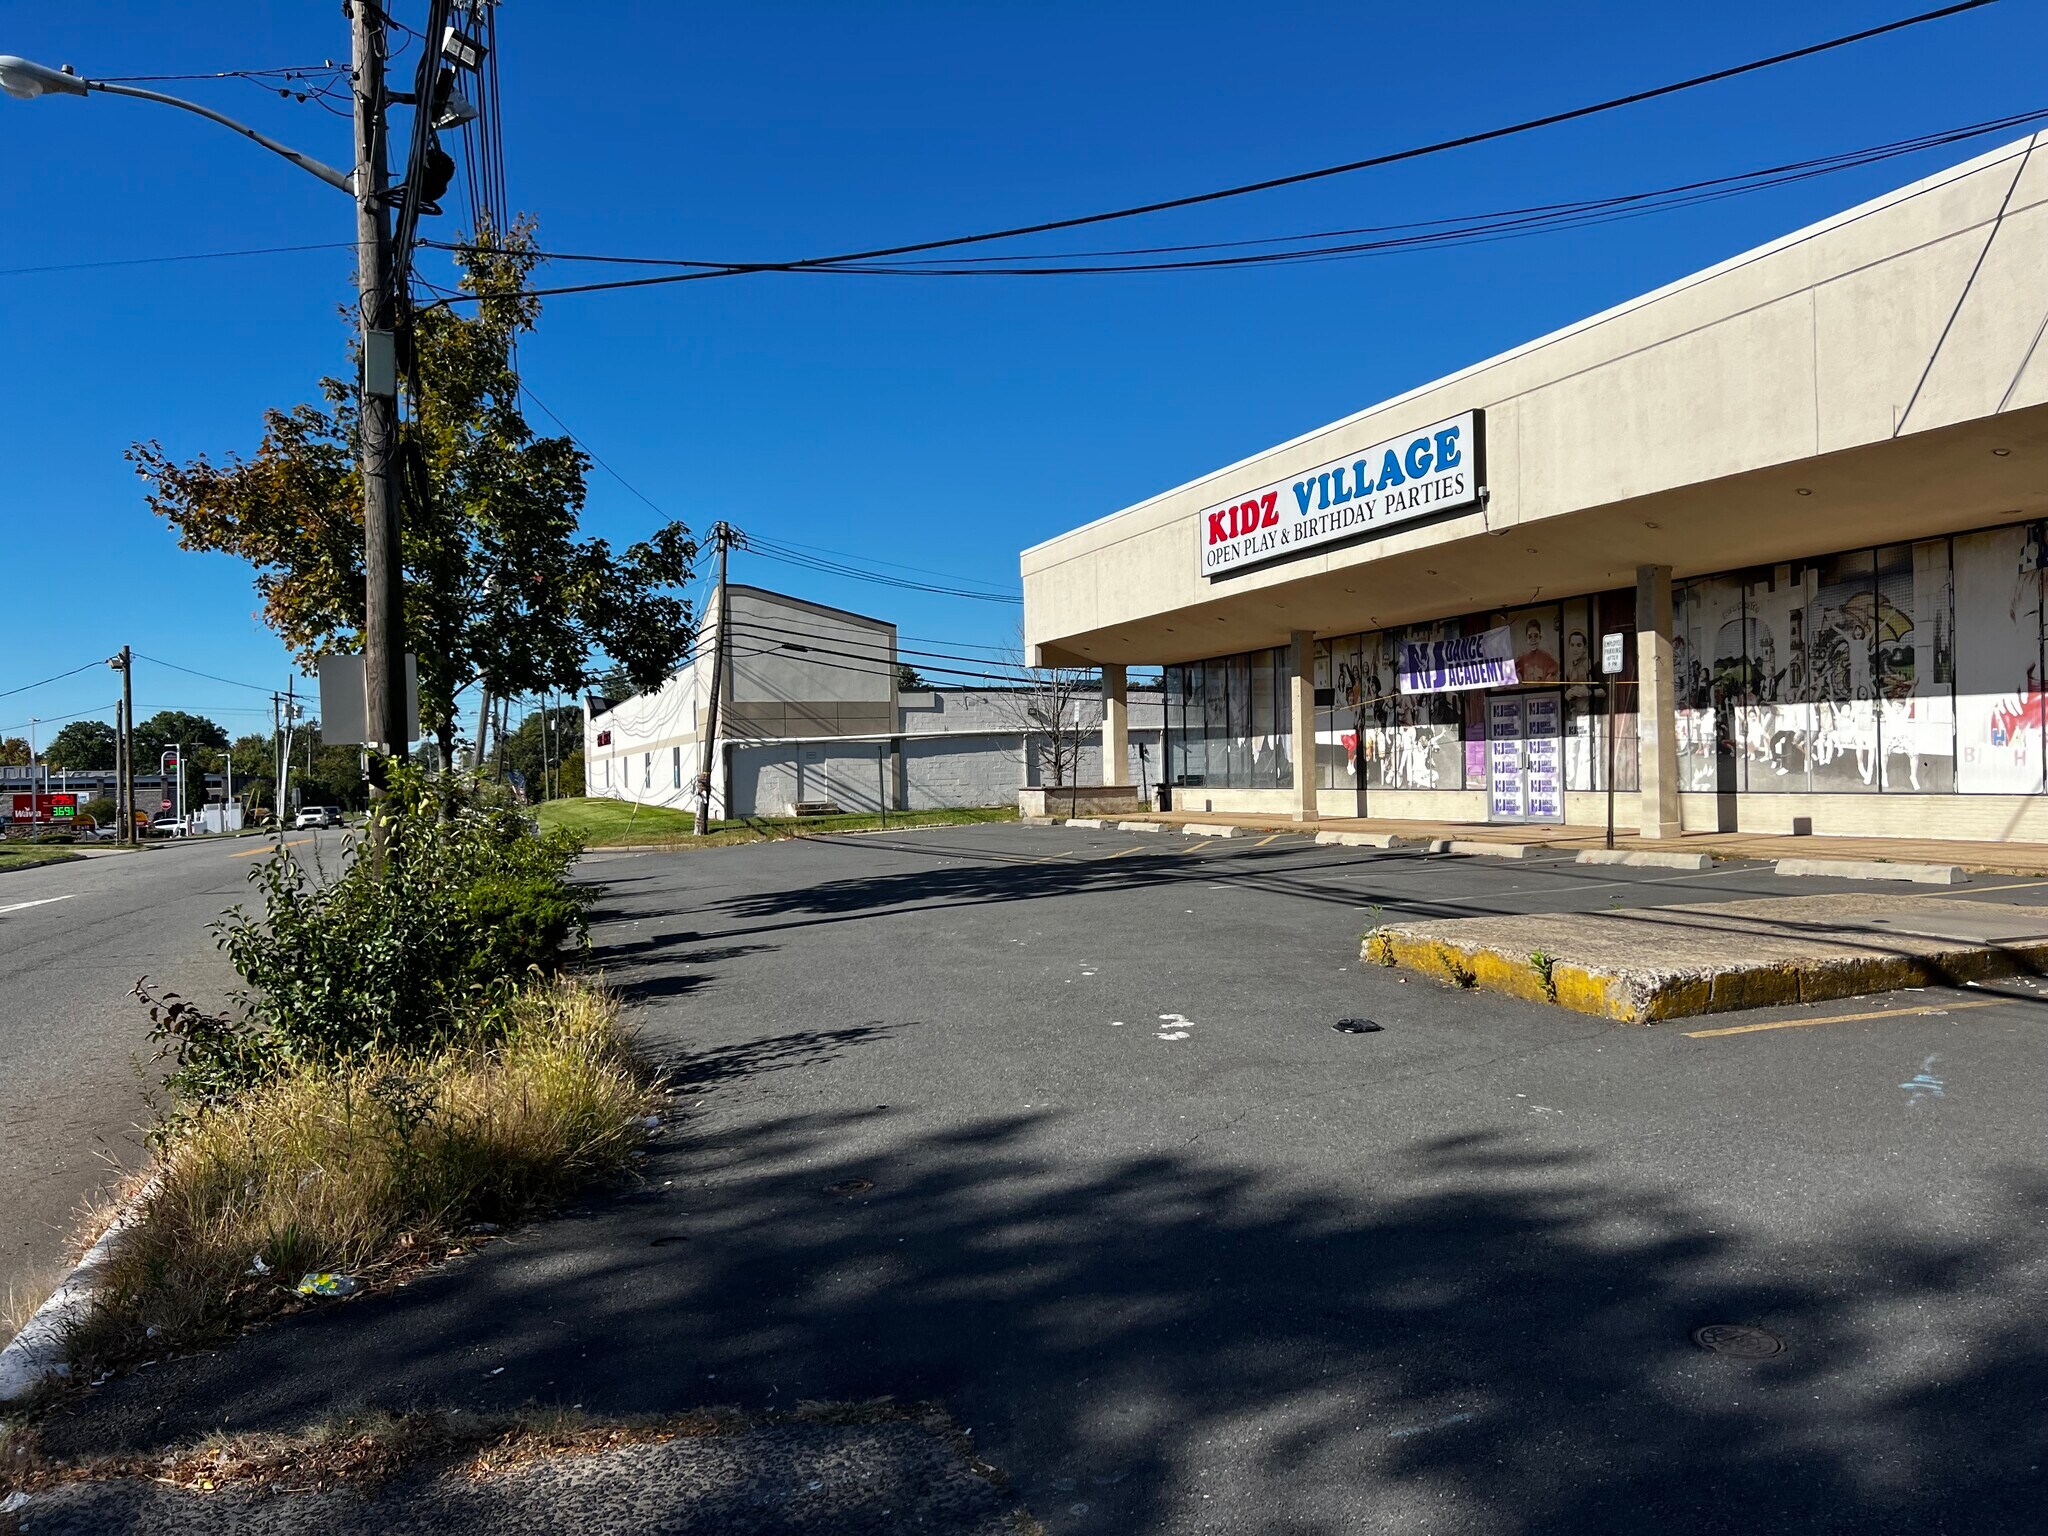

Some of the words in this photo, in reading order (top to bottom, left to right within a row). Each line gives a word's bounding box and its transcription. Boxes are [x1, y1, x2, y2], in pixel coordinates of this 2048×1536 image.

[1208, 490, 1280, 546] KIDZ
[1292, 425, 1461, 517] VILLAGE
[1206, 542, 1241, 567] OPEN
[1243, 530, 1277, 557] PLAY
[1280, 529, 1291, 546] &
[1293, 499, 1377, 542] BIRTHDAY
[1384, 472, 1465, 515] PARTIES
[1407, 640, 1446, 690] NJ
[1445, 634, 1484, 662] DANCE
[1448, 656, 1505, 687] ACADEMY
